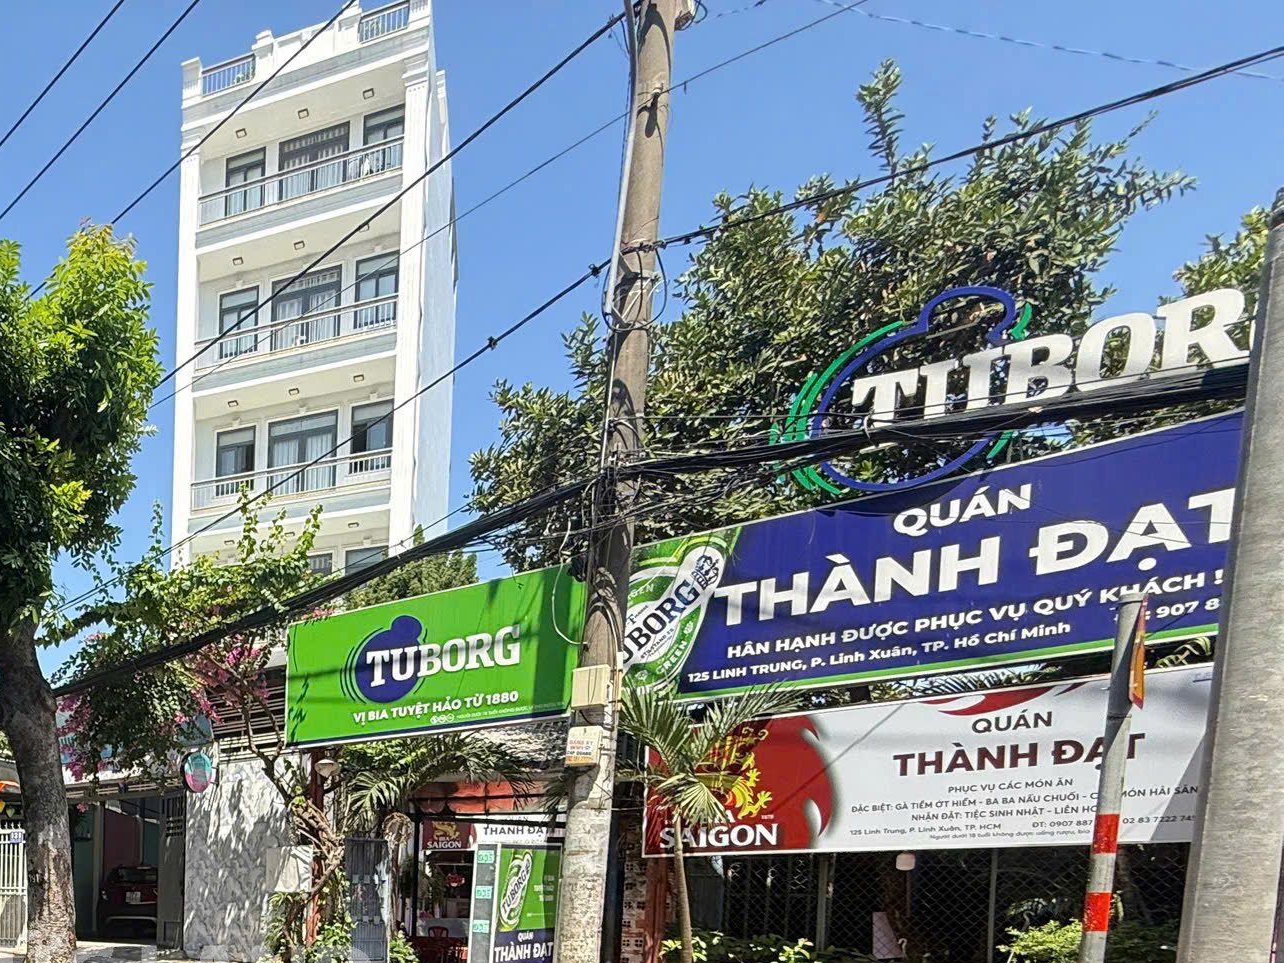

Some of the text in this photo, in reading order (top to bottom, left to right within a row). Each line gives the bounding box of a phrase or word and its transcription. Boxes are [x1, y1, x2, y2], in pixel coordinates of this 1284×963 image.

[852, 288, 1259, 428] TUBOR
[893, 483, 1032, 537] QUÁN
[714, 487, 1236, 626] THÀNH ĐẠT
[727, 640, 770, 659] HÂN
[775, 632, 836, 654] HẠNH
[841, 621, 909, 643] ĐƯỢC
[914, 609, 982, 635] PHỤC
[989, 601, 1027, 621] VỤ
[1032, 589, 1093, 616] QUÝ
[1099, 571, 1206, 604] KHÁCH
[1156, 600, 1200, 619] 907
[366, 624, 521, 688] TUBORG
[687, 621, 1071, 683] 125 LINH TRUNG, P. Linh Xuân, TP. Hồ Chí Minh
[352, 690, 520, 728] VỊ BIA TUYỆT HẢO TỪ 1880
[971, 709, 1053, 734] QUÁN
[893, 742, 1039, 777] THÀNH
[948, 777, 1074, 796] PHỤC VỤ CÁC MÓN ĂN
[851, 802, 870, 814] ĐẶC
[895, 800, 909, 811] GÀ
[985, 796, 1000, 806] BA
[1002, 795, 1016, 805] BA
[1043, 791, 1080, 803] CHUỐI
[911, 812, 938, 823] NHẬN
[965, 809, 987, 821] TIỆC
[989, 807, 1013, 818] SINH
[1016, 805, 1045, 818] NHẬT
[1054, 803, 1080, 815] LIÊN
[660, 823, 779, 849] SAIGON
[849, 829, 863, 837] 125
[864, 827, 881, 836] Linh
[918, 824, 936, 833] Linh
[979, 822, 1001, 831] HCM
[1049, 819, 1074, 828] 0907
[1076, 818, 1093, 827] 887
[427, 840, 462, 849] SAIGON
[502, 868, 528, 915] TUBORG
[494, 941, 554, 963] THÀNH ĐẠT
